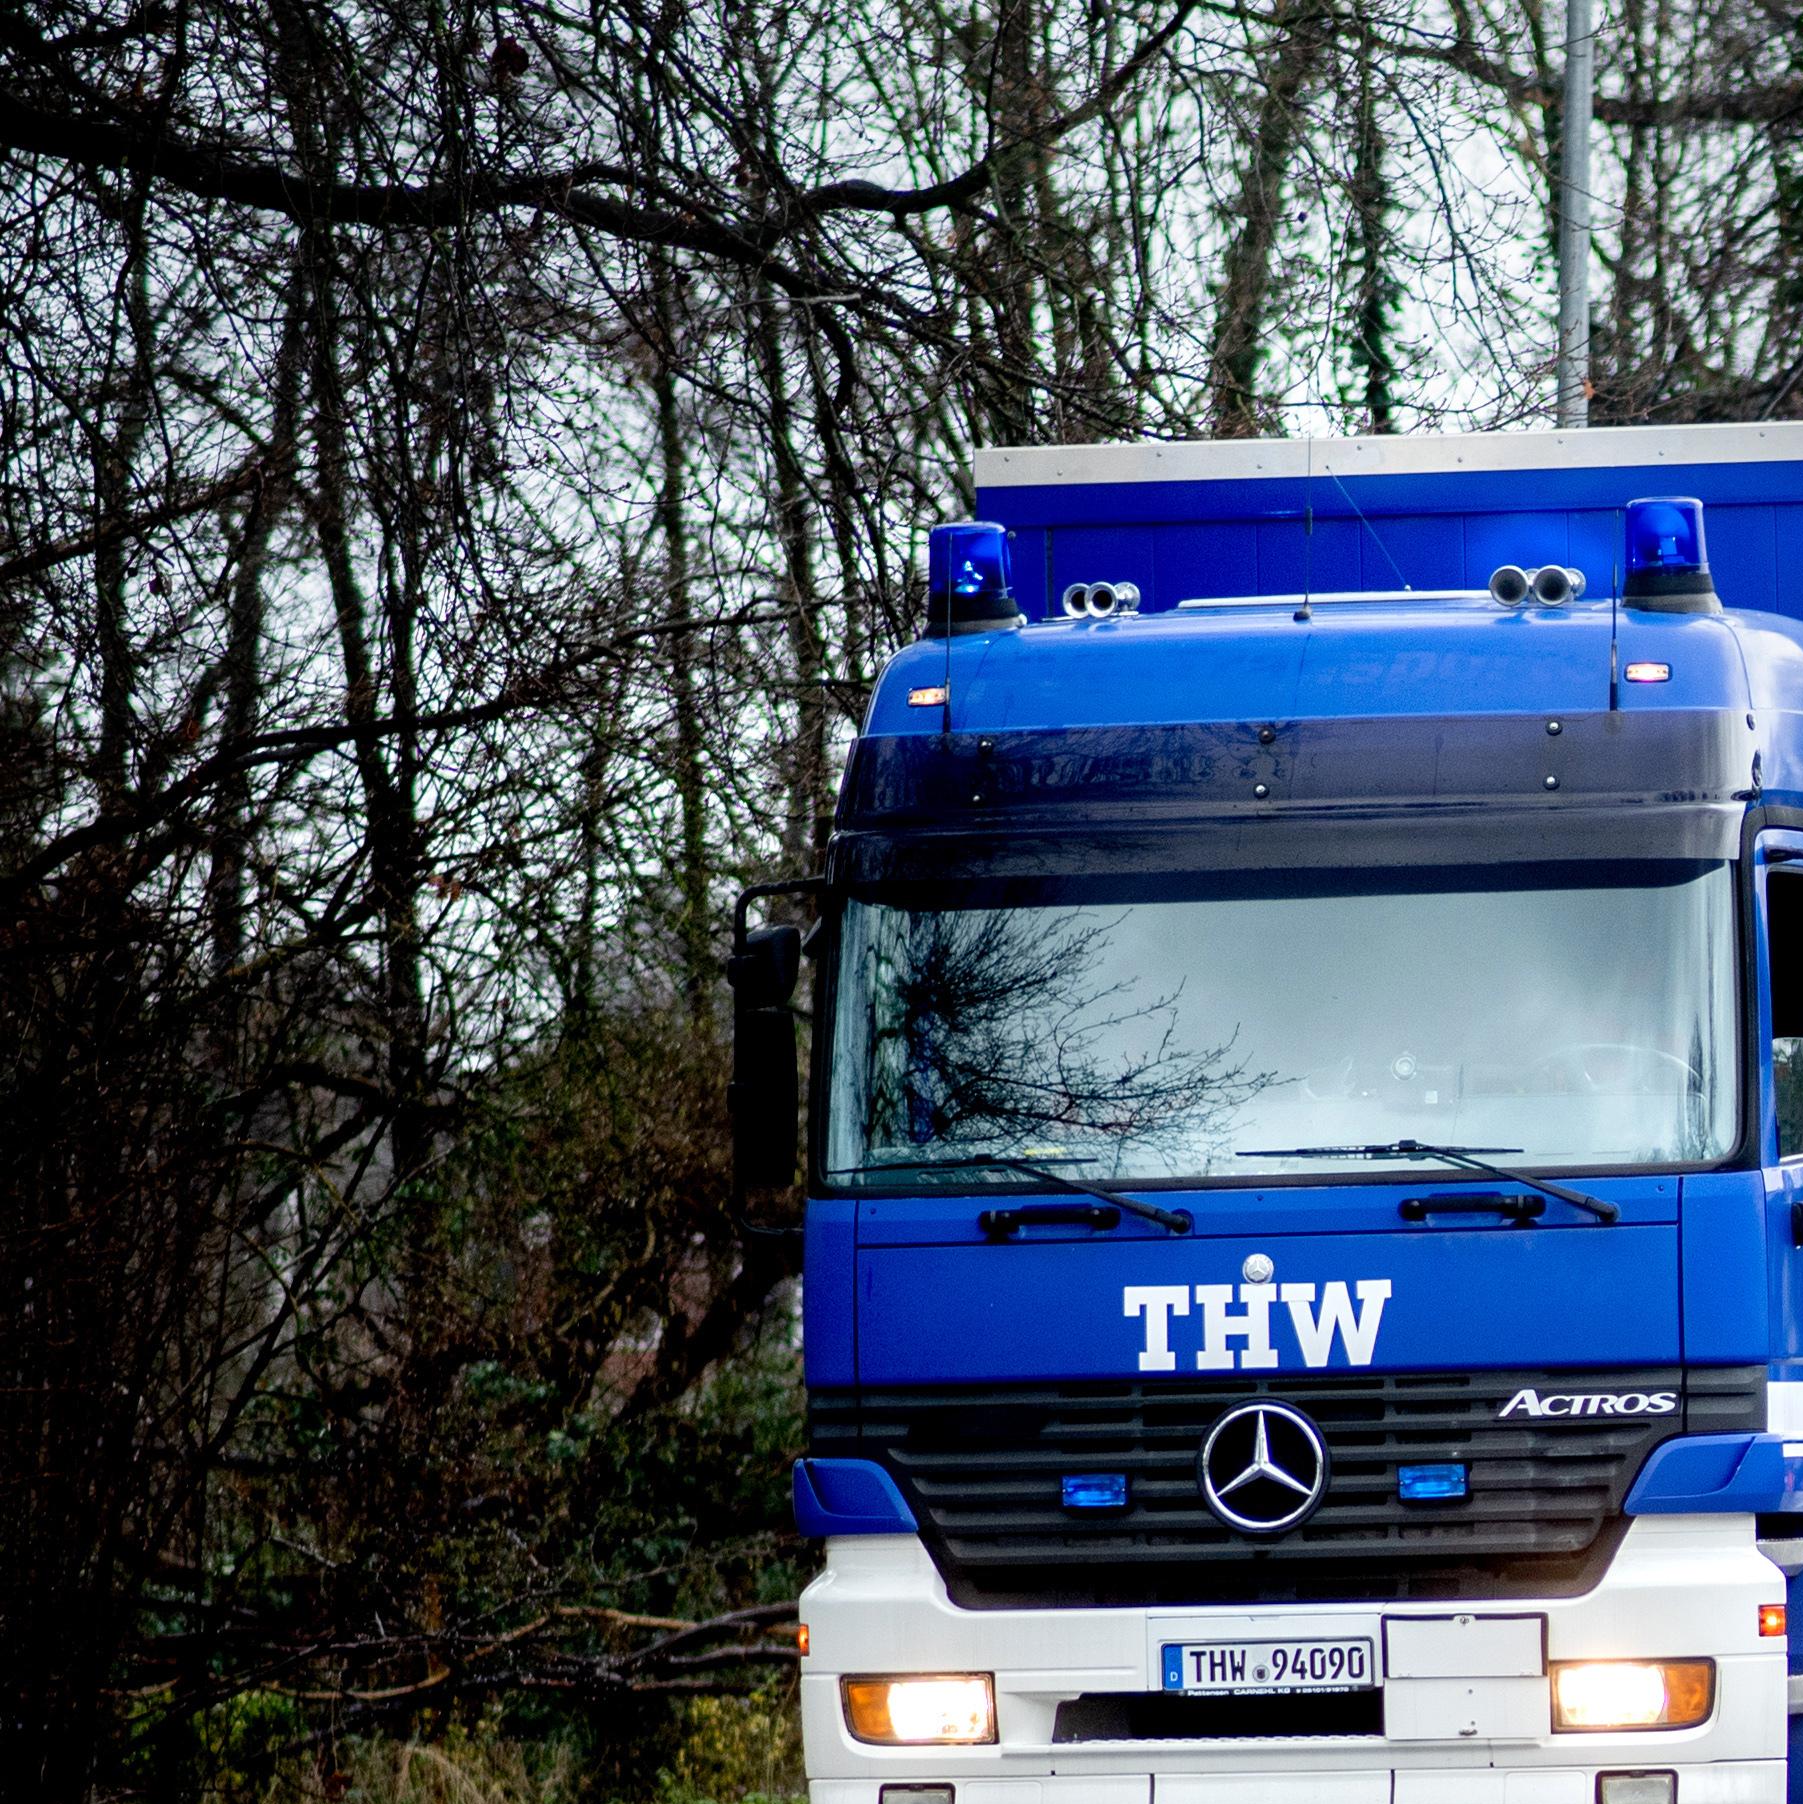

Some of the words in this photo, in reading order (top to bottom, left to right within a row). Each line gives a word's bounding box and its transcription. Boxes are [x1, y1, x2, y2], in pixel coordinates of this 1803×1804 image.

[1123, 1278, 1392, 1372] THW
[1169, 1672, 1178, 1682] D
[1271, 1647, 1365, 1681] 94090
